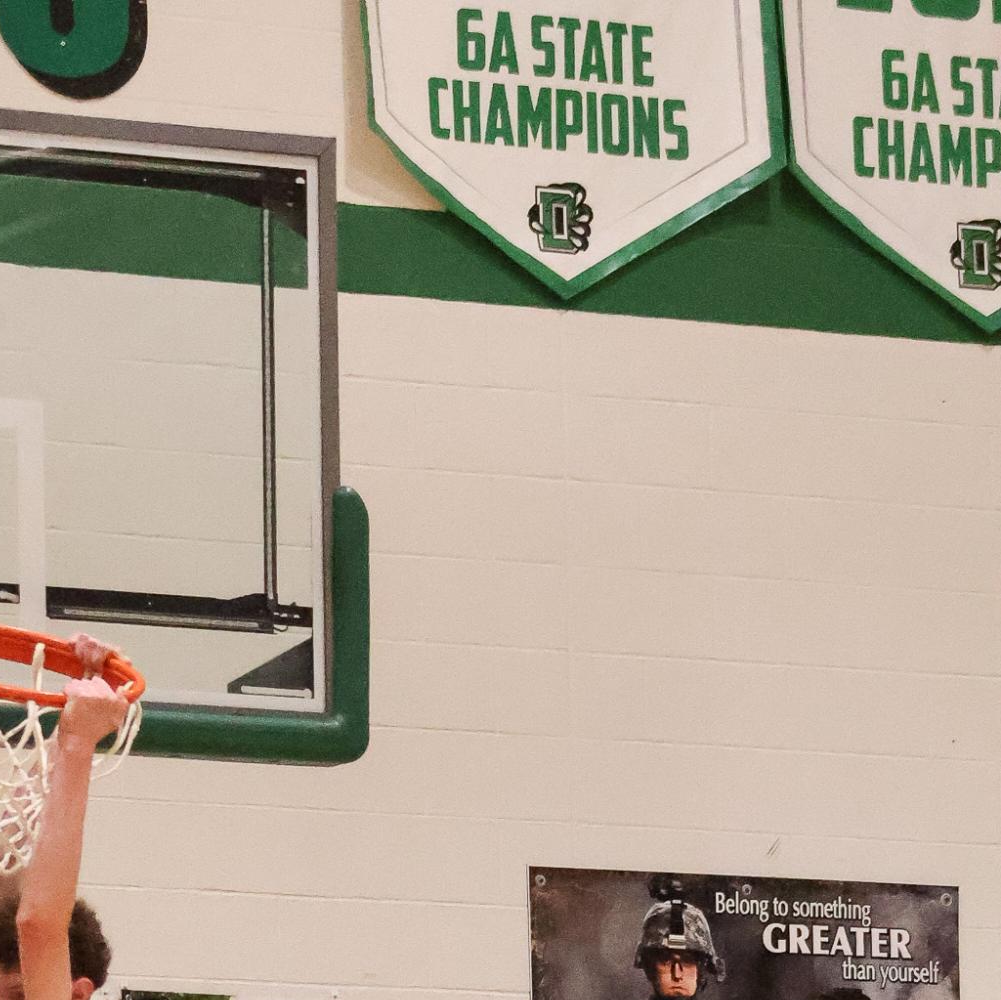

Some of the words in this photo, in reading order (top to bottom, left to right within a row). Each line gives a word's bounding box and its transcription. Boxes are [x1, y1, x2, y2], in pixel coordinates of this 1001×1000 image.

[457, 9, 519, 75] 6A
[531, 15, 654, 87] STATE
[882, 49, 940, 114] 6A
[950, 56, 1001, 119] ST
[428, 77, 689, 161] CHAMPIONS
[715, 891, 769, 922] Belong
[773, 897, 789, 916] to
[793, 896, 871, 927] something
[762, 922, 912, 960] GREATER
[842, 957, 876, 981] than
[880, 960, 941, 989] yourself
